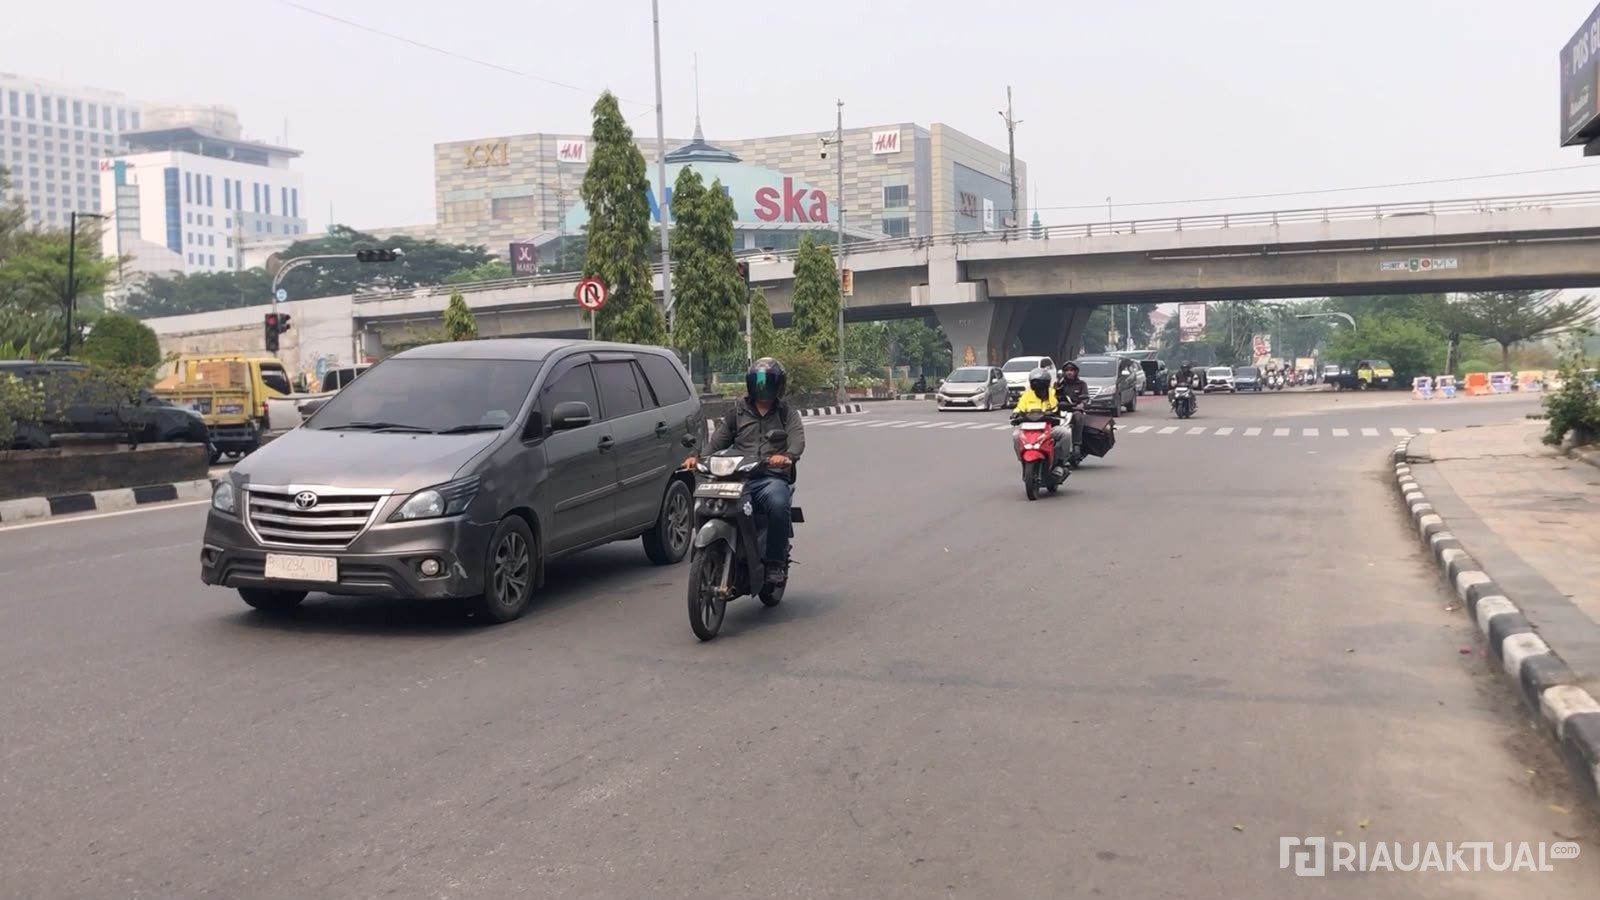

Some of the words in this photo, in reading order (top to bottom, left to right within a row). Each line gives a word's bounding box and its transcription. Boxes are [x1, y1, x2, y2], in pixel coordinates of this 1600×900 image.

[1573, 32, 1589, 75] POS
[464, 143, 510, 168] XXI
[754, 177, 828, 223] ska
